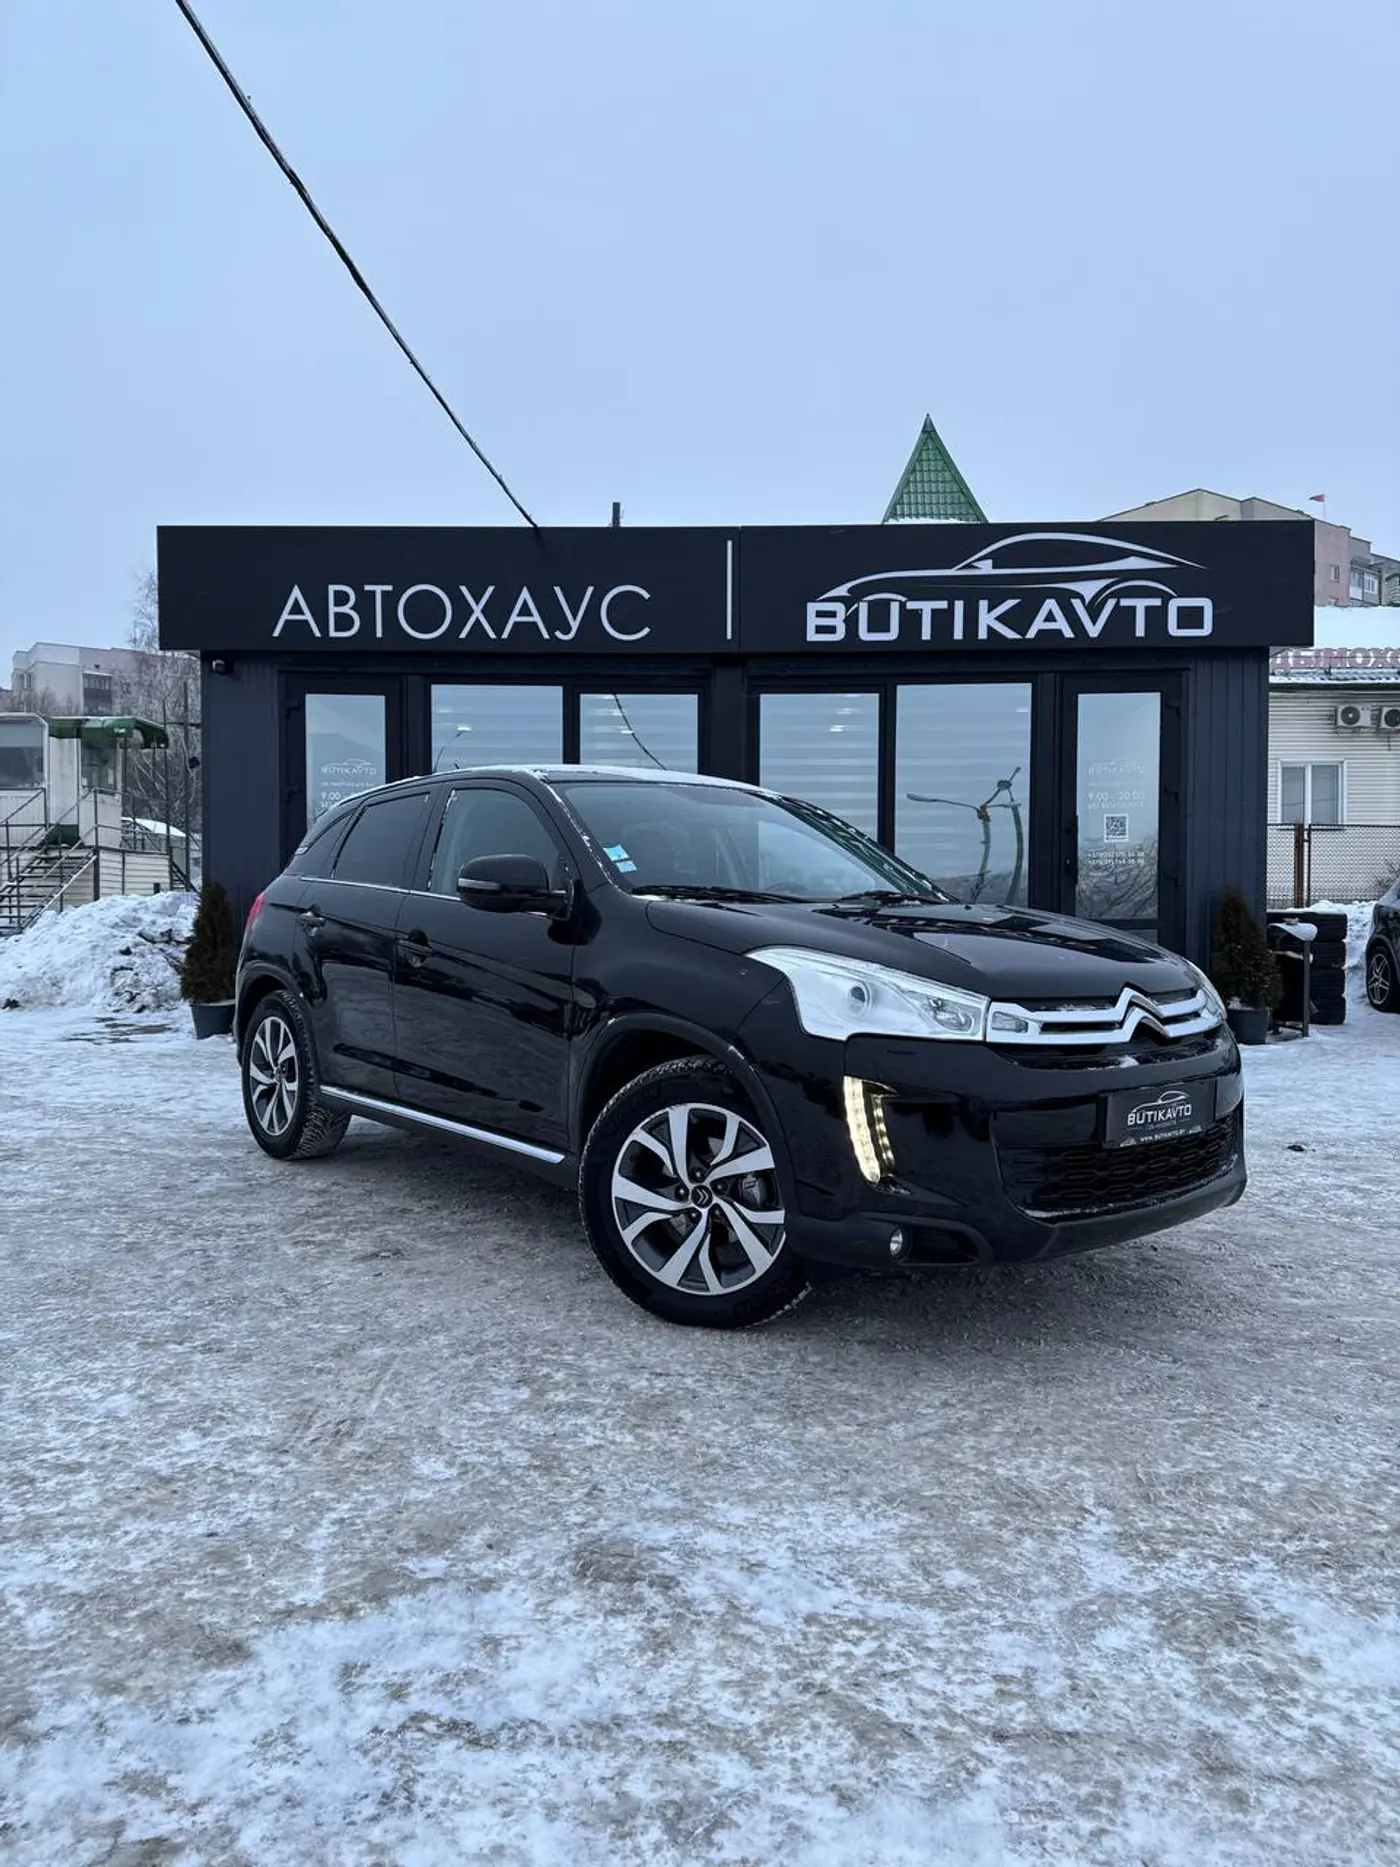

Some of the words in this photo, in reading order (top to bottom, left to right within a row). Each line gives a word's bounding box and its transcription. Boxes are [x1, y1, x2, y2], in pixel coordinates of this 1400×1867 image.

[272, 583, 651, 641] АВТОХАУС
[806, 597, 1213, 642] BUTIKAVTO
[1127, 1104, 1192, 1126] BUTIKAVTO
